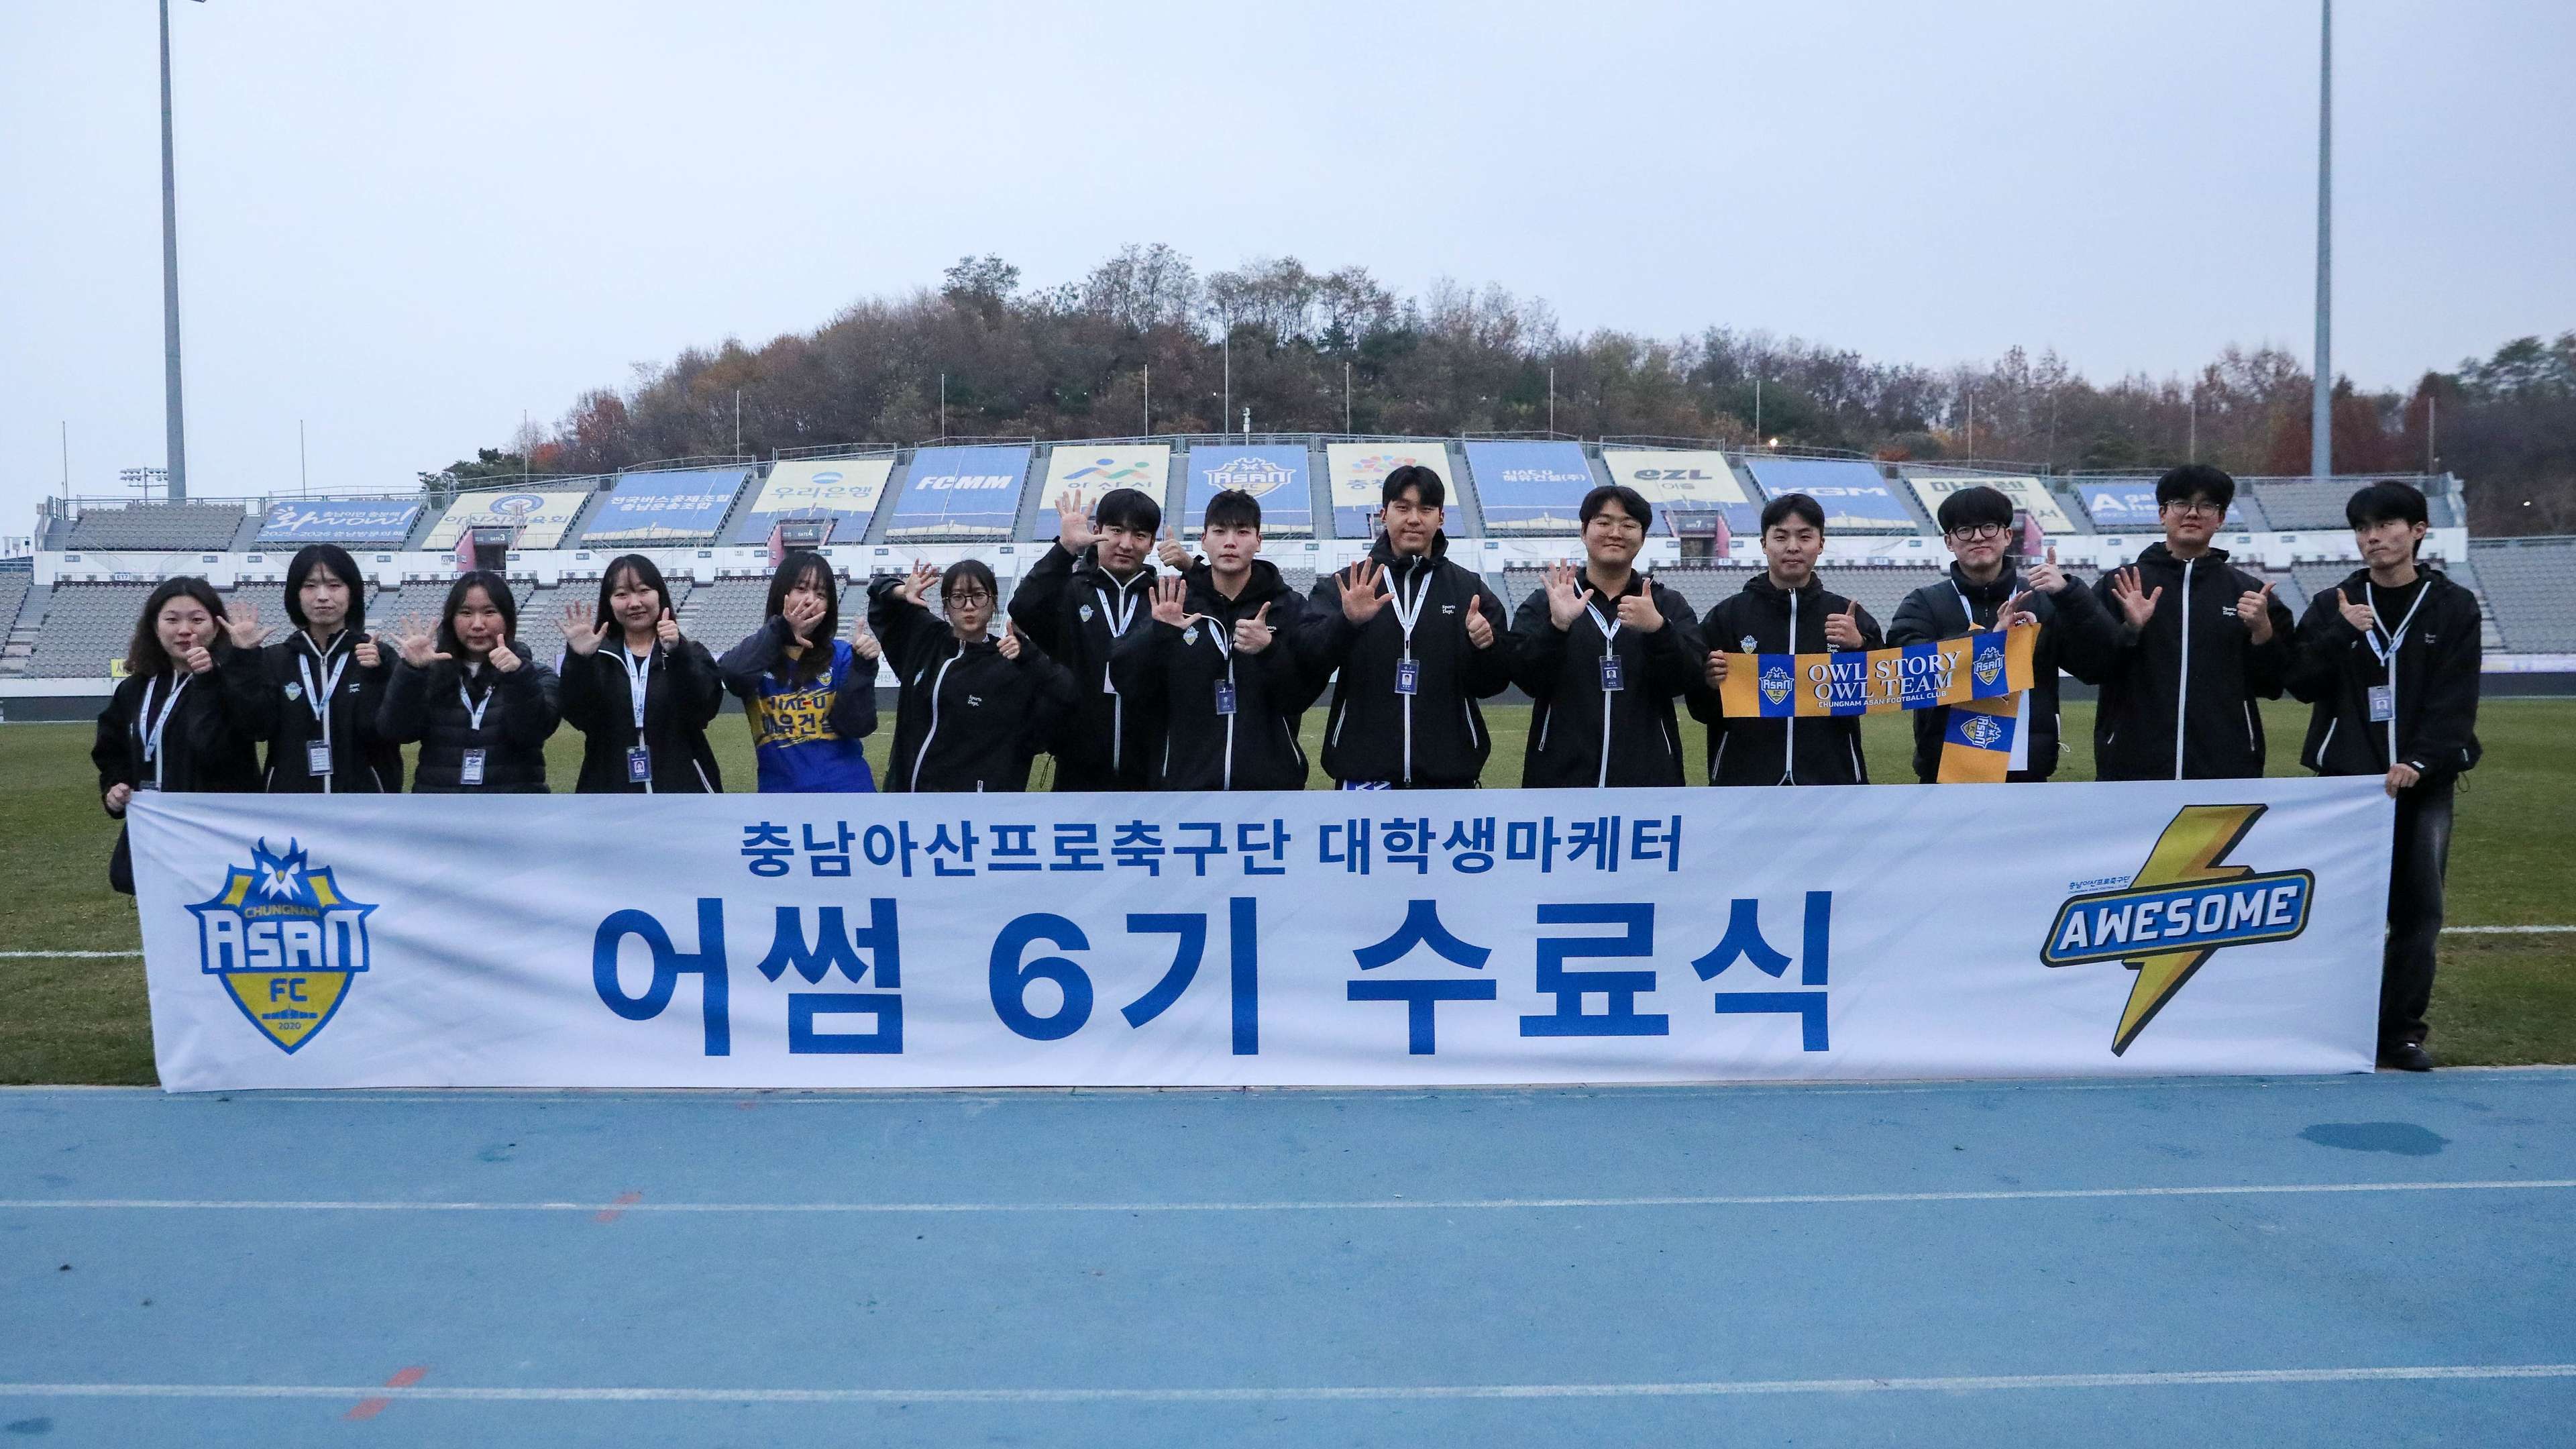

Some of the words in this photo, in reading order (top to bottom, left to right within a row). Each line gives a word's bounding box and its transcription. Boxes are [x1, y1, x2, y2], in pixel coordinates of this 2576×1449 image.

[915, 476, 1014, 489] FCMM
[1214, 472, 1285, 484] ASAN
[770, 486, 872, 498] 우리은행
[1769, 486, 1888, 496] KGM
[1808, 663, 1868, 682] OWL
[1875, 650, 1962, 679] STORY
[1976, 658, 2001, 672] ASAN
[1763, 679, 1790, 690] ASAN
[1814, 682, 1874, 700] OWL
[1880, 671, 1954, 697] TEAM
[1886, 694, 1925, 704] FOOTBALL
[1927, 690, 1947, 699] CLUB
[1974, 718, 1989, 745] ASAN
[741, 818, 1291, 877] 충남아산프로축구단
[1320, 815, 1683, 875] 대학생마케터
[2069, 875, 2131, 890] 충남아산프로축구단
[244, 906, 320, 918] CHUNGNAM
[2057, 885, 2298, 950] AWESOME
[199, 910, 365, 969] ASAN
[593, 898, 904, 1056] 어썸
[989, 897, 1258, 1055] 6기
[1347, 892, 1832, 1055] 수료식
[270, 978, 308, 1002] FC
[278, 1022, 301, 1030] 2020
